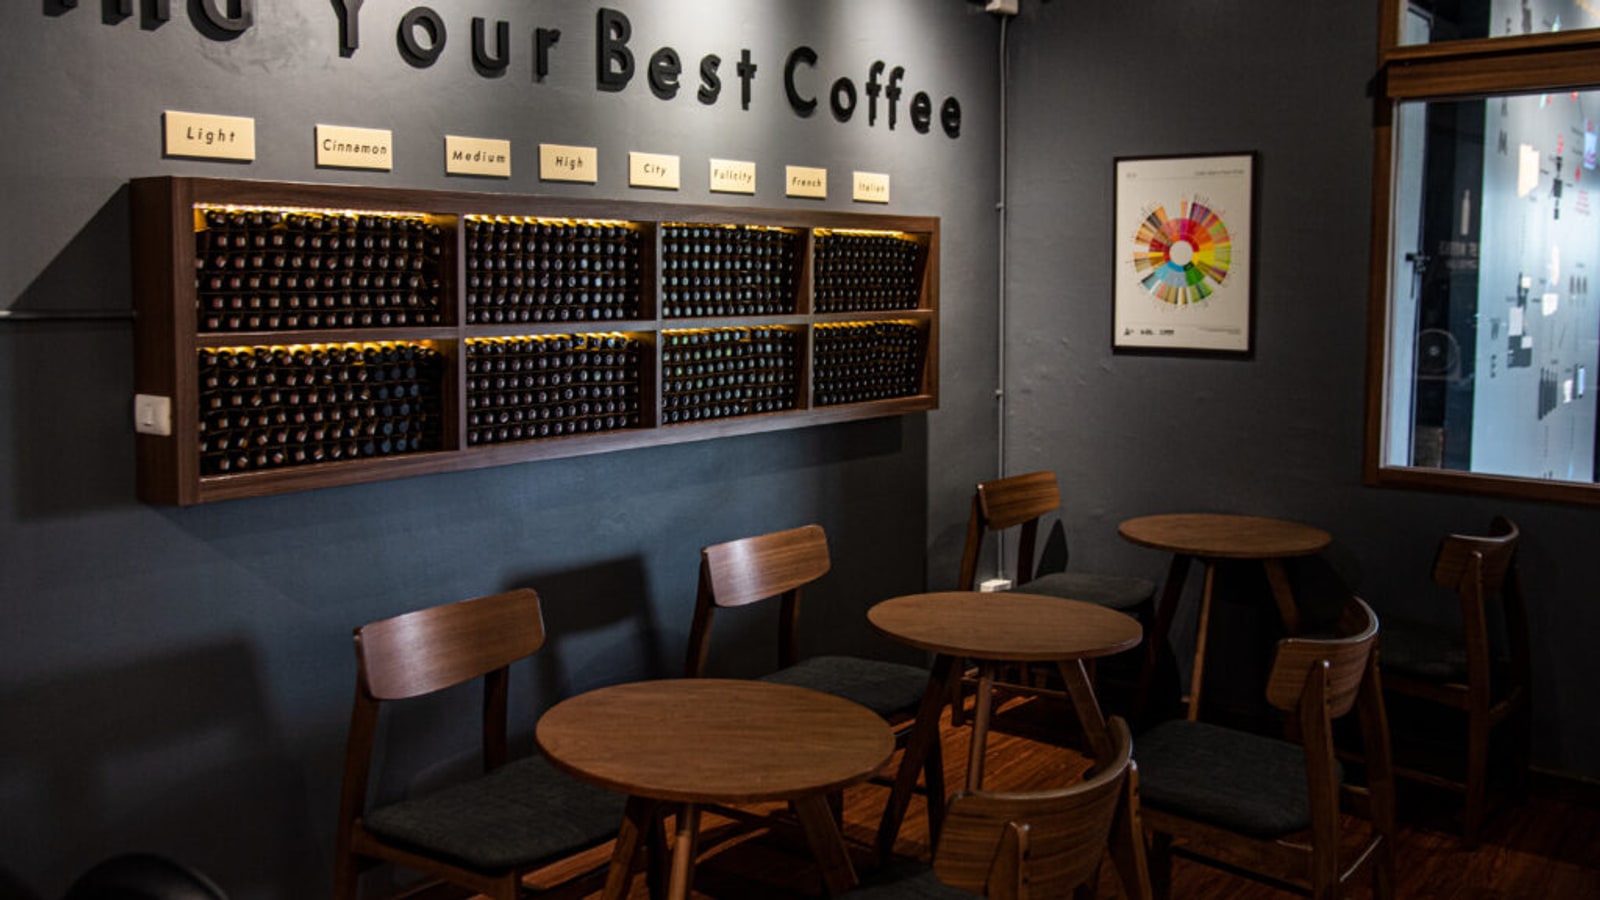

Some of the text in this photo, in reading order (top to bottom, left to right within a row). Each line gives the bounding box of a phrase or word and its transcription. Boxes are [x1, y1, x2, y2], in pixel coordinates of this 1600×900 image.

[331, 0, 561, 83] Your
[596, 7, 756, 109] Best
[784, 46, 963, 138] Coffee
[187, 126, 236, 146] Light
[322, 138, 388, 156] Cinnamon
[452, 149, 507, 164] Medium
[555, 155, 584, 171] High
[643, 163, 667, 177] City
[792, 176, 822, 188] French
